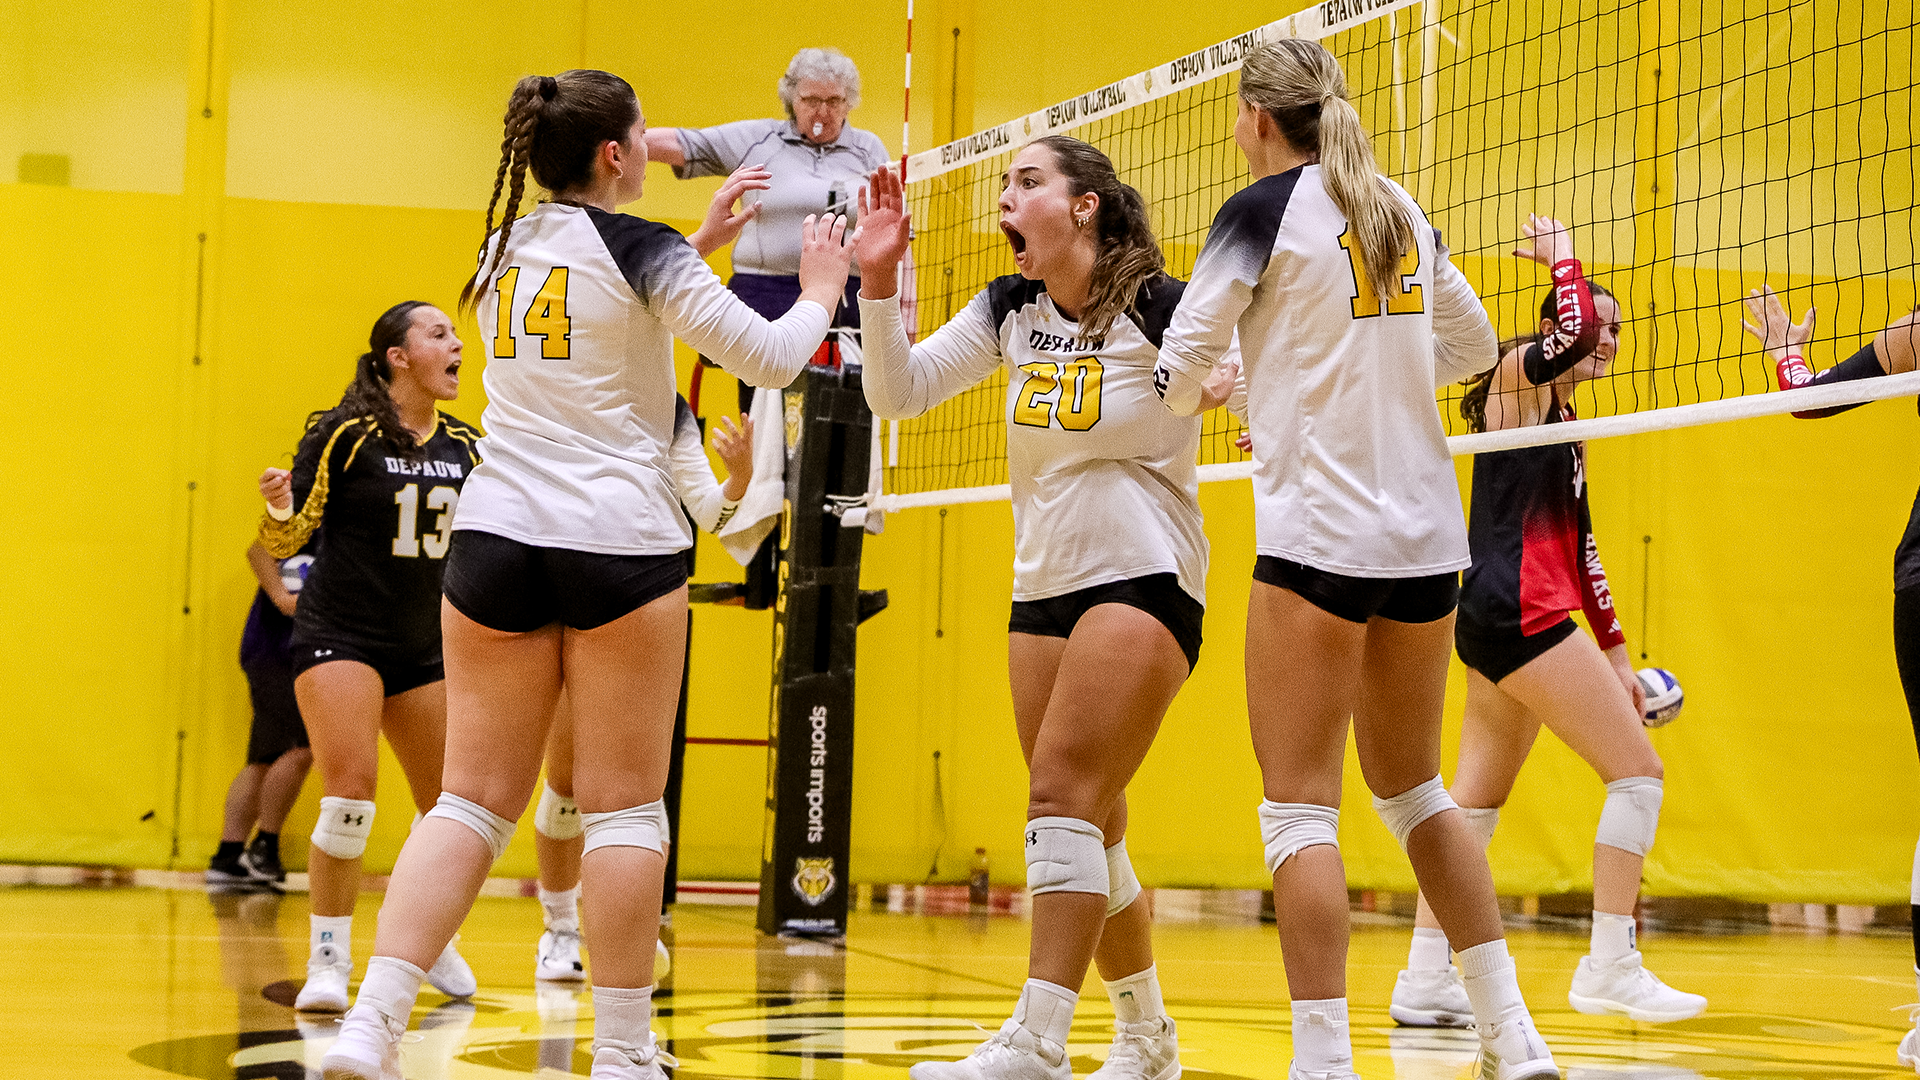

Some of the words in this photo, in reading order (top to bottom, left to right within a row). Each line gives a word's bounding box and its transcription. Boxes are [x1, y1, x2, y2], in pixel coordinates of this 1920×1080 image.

[493, 266, 571, 360] 14
[1542, 283, 1582, 361] SCARLET
[1013, 355, 1104, 432] 20
[385, 456, 463, 479] DEPAUW
[392, 482, 459, 559] 13
[1585, 532, 1614, 611] HAWKS
[809, 705, 827, 767] sports
[806, 768, 826, 844] imports
